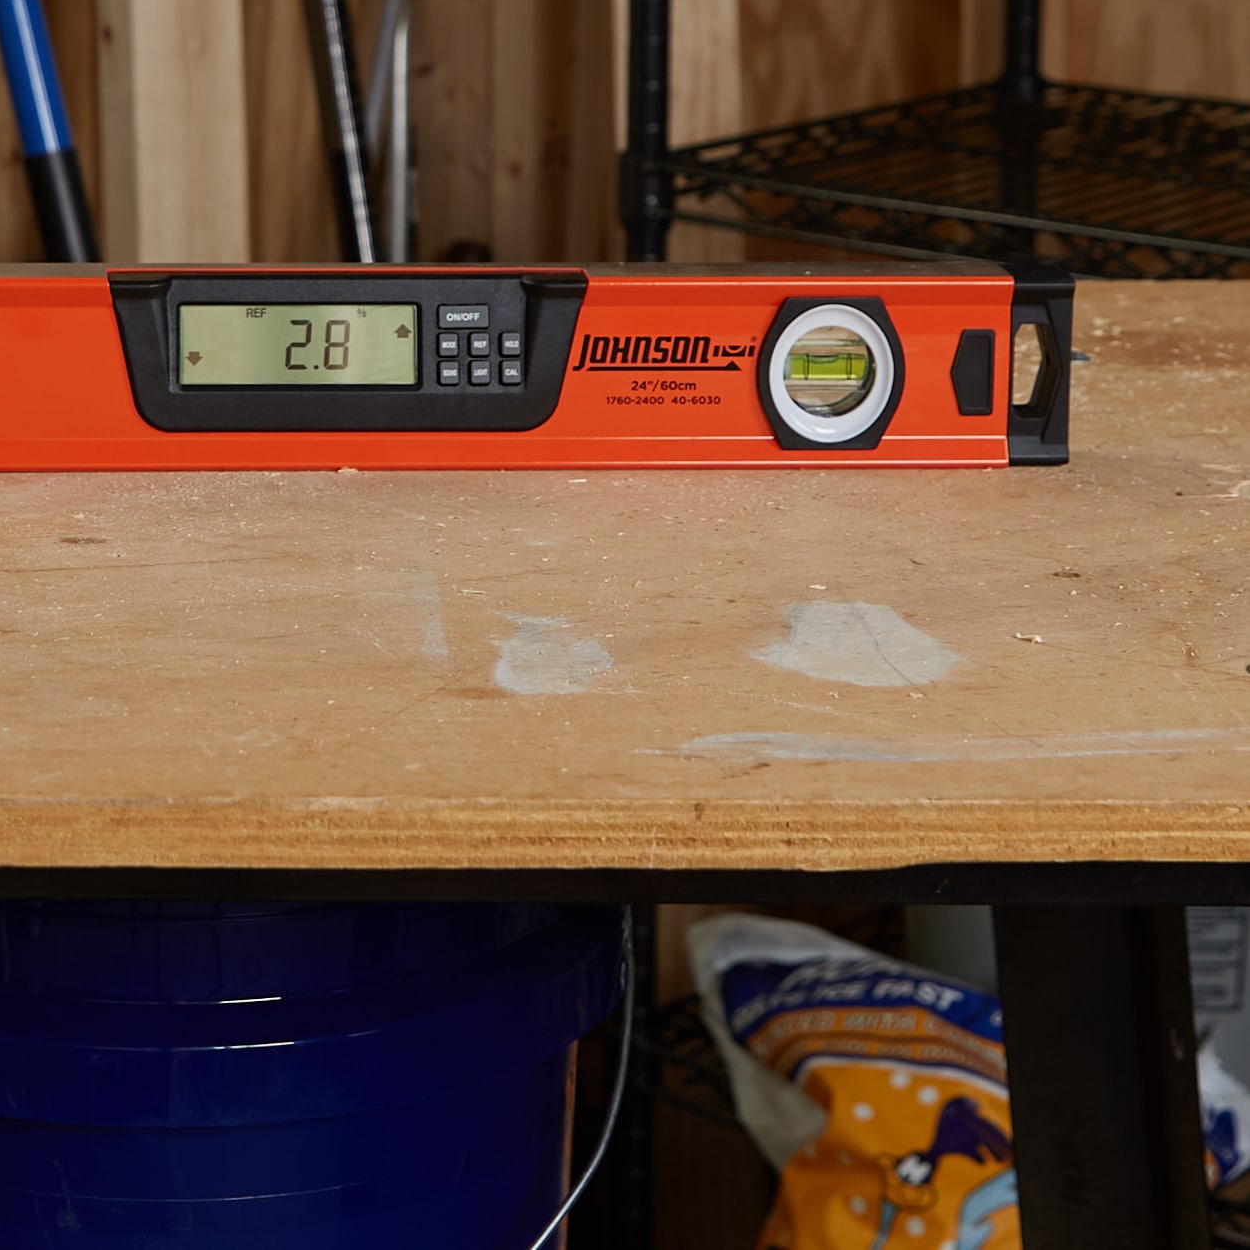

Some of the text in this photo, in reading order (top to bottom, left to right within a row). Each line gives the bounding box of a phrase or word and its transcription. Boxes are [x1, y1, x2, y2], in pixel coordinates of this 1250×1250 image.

[246, 307, 267, 318] REF
[445, 312, 481, 322] ON/OFF
[285, 320, 349, 370] 2.8
[573, 334, 712, 372] JOHNSON
[504, 368, 519, 376] CAL
[606, 395, 721, 405] 1760-2400 40-6030
[870, 978, 965, 1011] FAST
